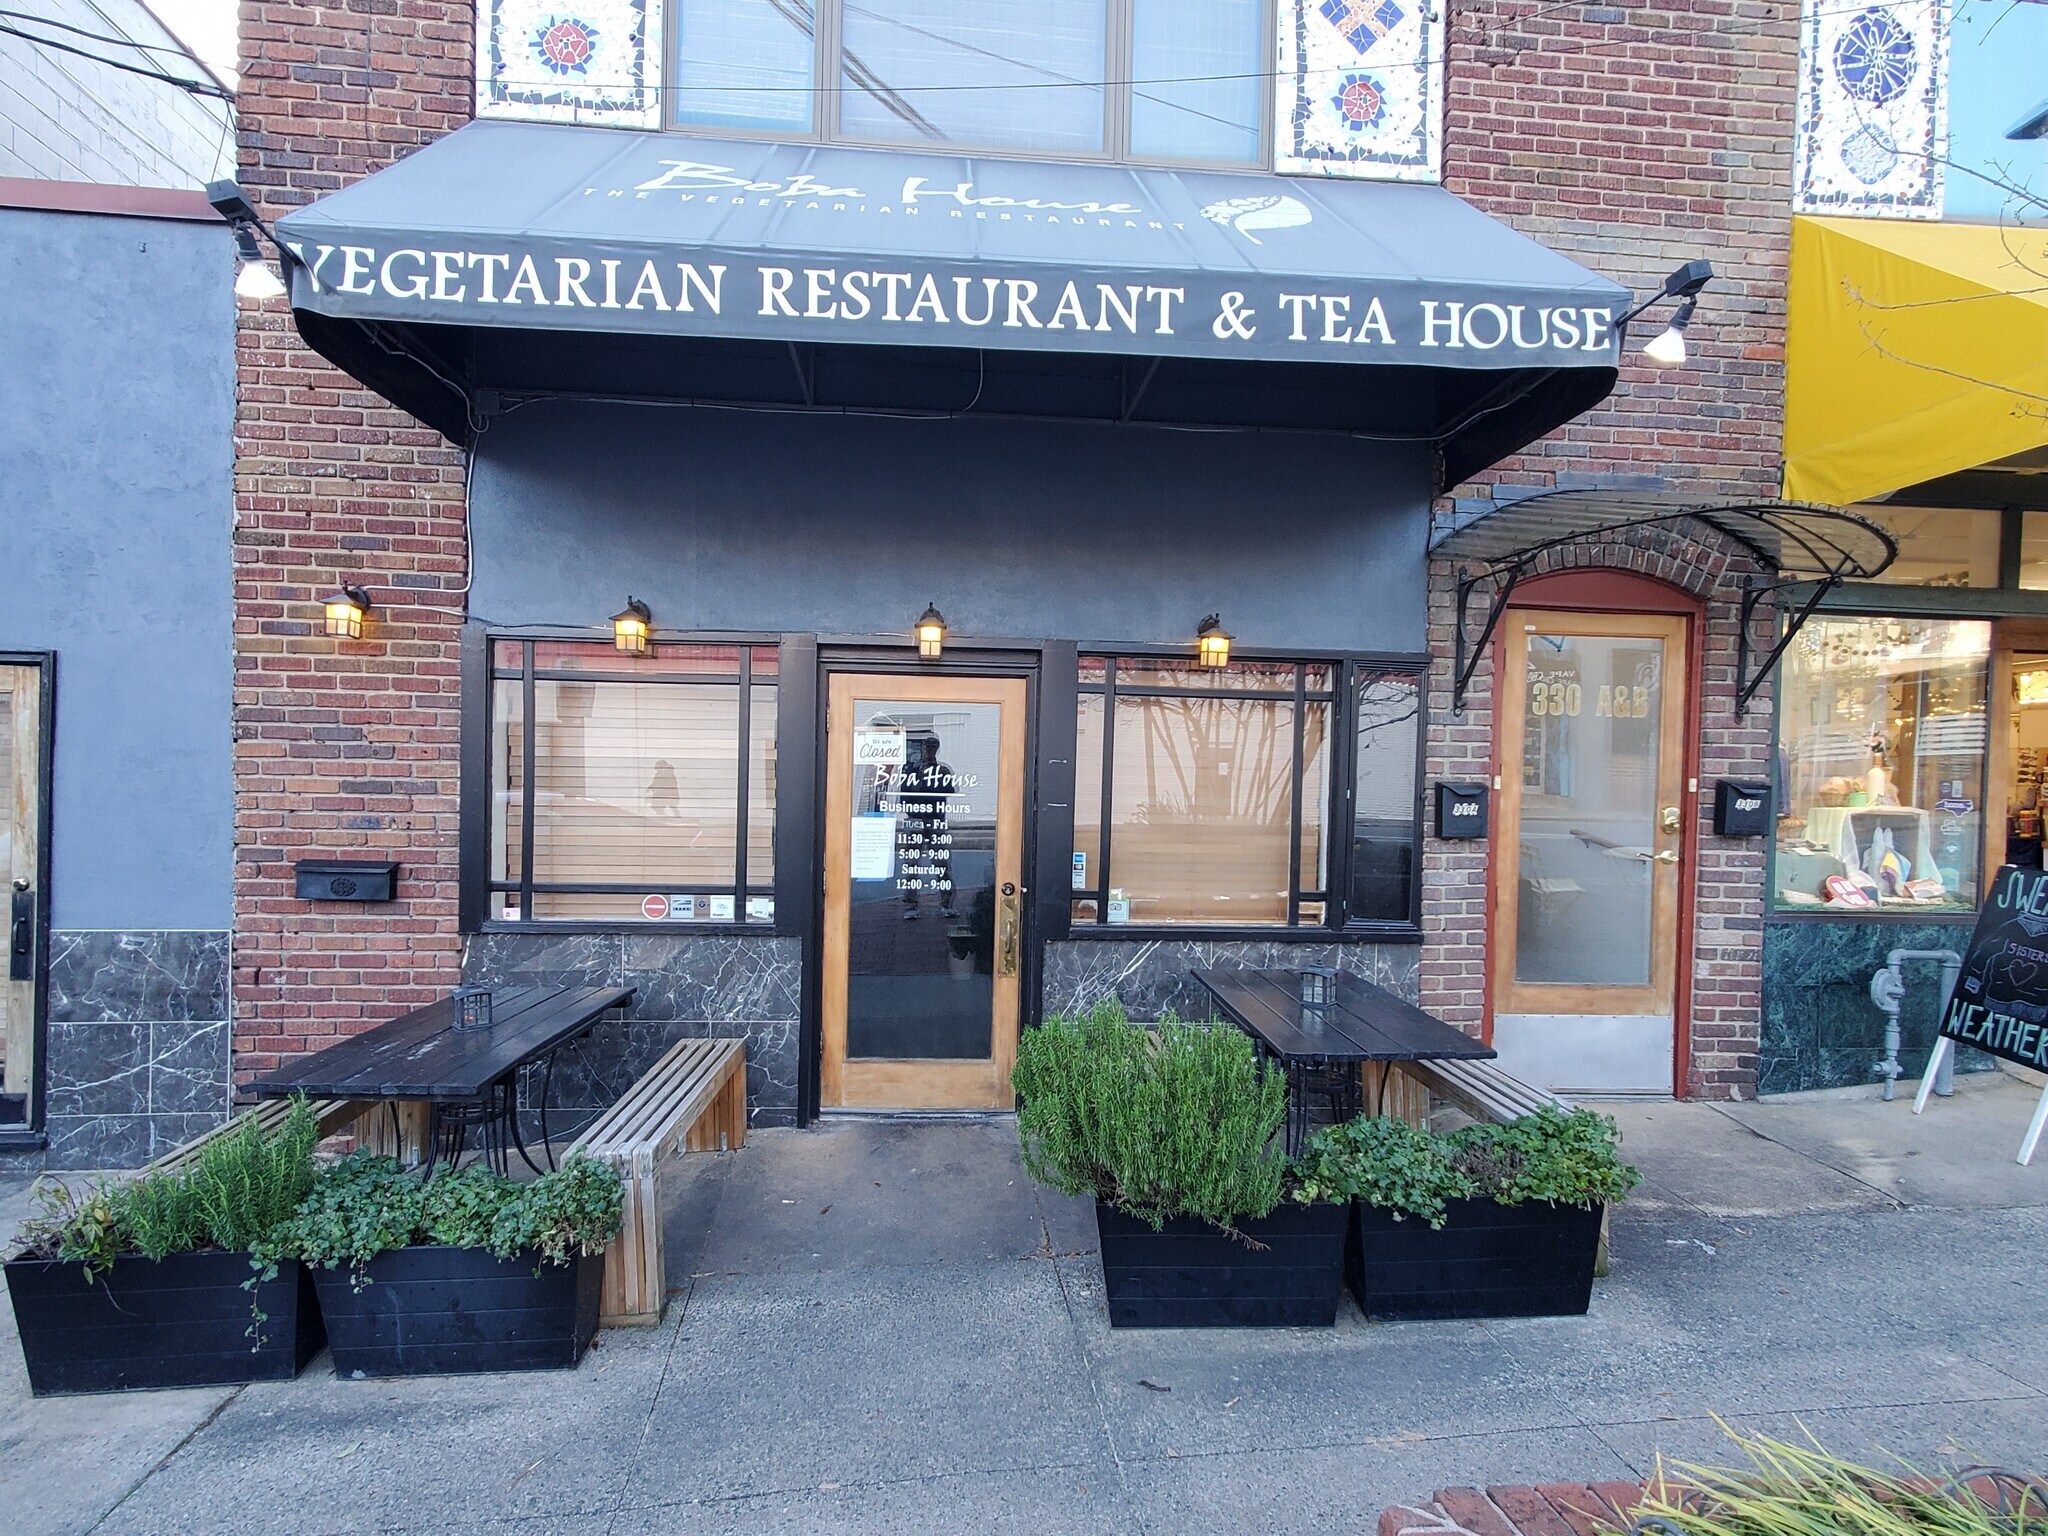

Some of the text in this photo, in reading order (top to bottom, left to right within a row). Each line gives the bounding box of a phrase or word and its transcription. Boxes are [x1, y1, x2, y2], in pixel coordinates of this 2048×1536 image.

[634, 160, 1142, 214] Boba House
[584, 187, 1185, 231] THE VEGETARIAN RESTAURANT
[287, 241, 1612, 352] VEGETARIAN RESTAURANT & TEA HOUSE
[1532, 682, 1649, 719] 330 A&B
[859, 743, 902, 759] Closed
[873, 763, 979, 789] Boba House
[879, 800, 971, 814] Business Hours
[933, 819, 949, 830] Fri
[897, 833, 924, 845] 11:30
[931, 834, 953, 845] 3:00
[898, 848, 921, 860] 5:00
[928, 849, 950, 860] 9:00
[901, 863, 947, 877] Saturday
[896, 878, 923, 890] 12:00
[930, 879, 952, 891] 9:00
[1997, 871, 2048, 916] SWE
